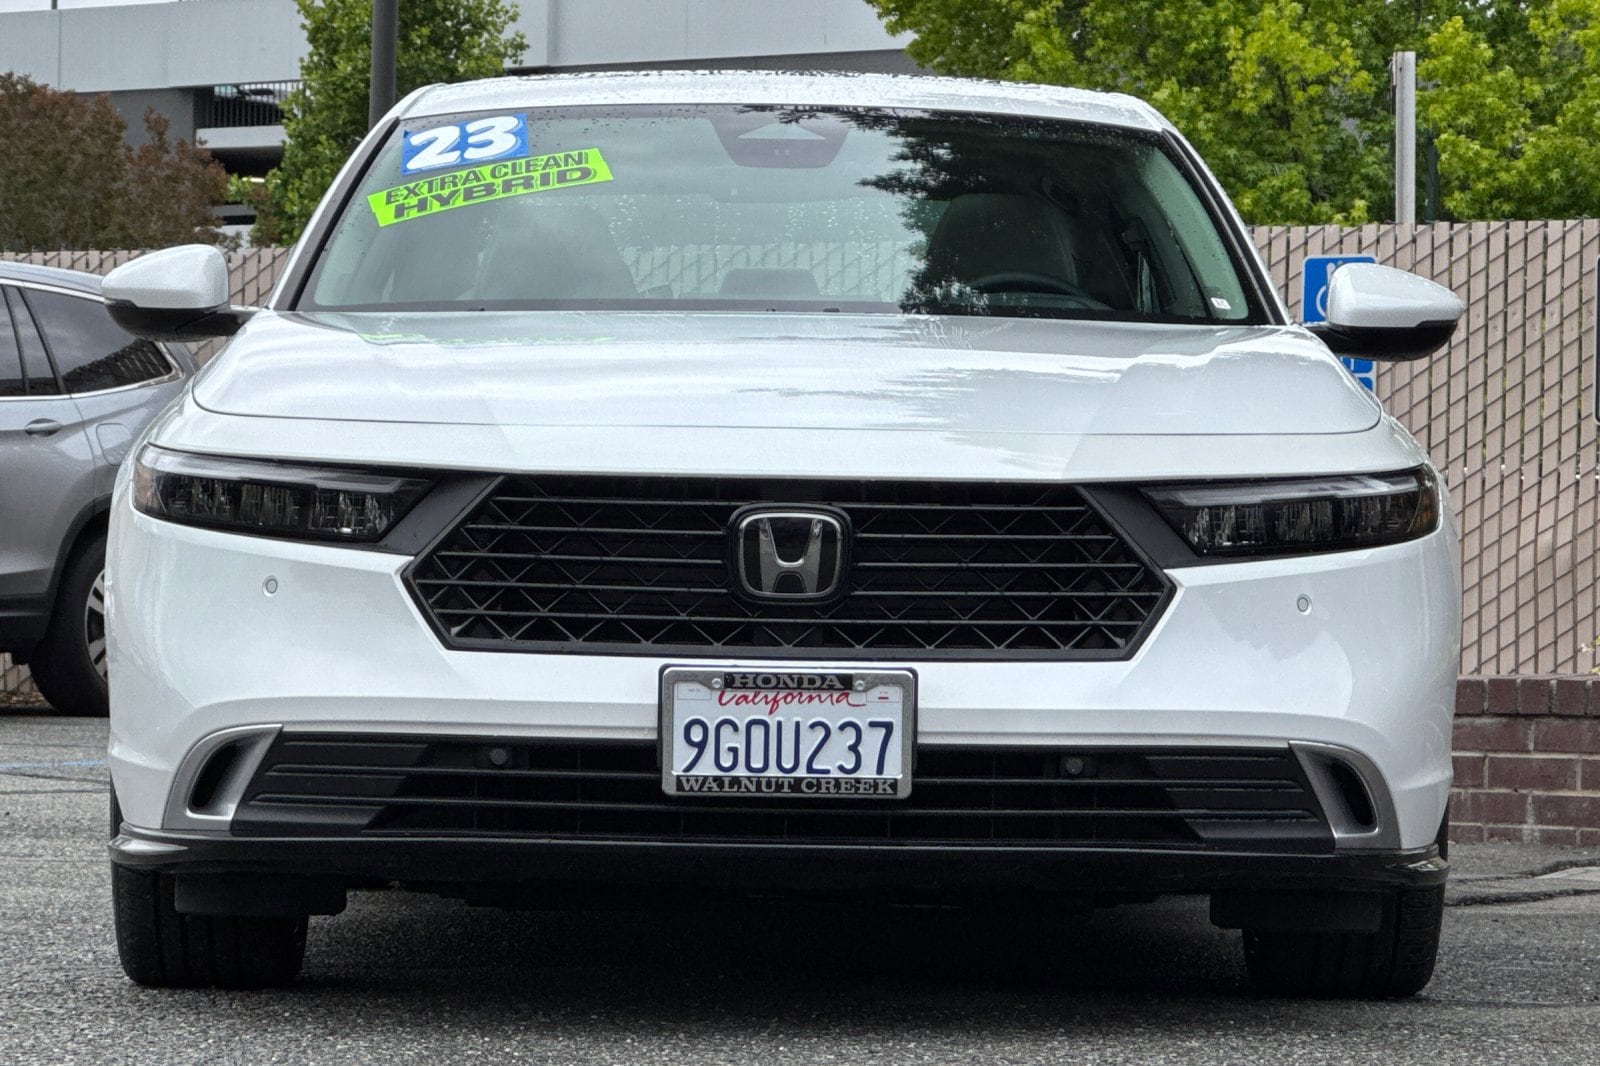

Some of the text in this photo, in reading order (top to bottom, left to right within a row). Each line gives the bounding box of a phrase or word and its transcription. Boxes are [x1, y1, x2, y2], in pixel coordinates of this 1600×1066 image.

[406, 115, 522, 170] 23
[385, 151, 589, 205] EXTRA CLEAN
[394, 165, 596, 219] HYBRID
[718, 690, 867, 715] California
[733, 673, 844, 689] HONDA
[682, 717, 894, 776] 9GOU237
[679, 776, 895, 795] WALNUT CREEK
